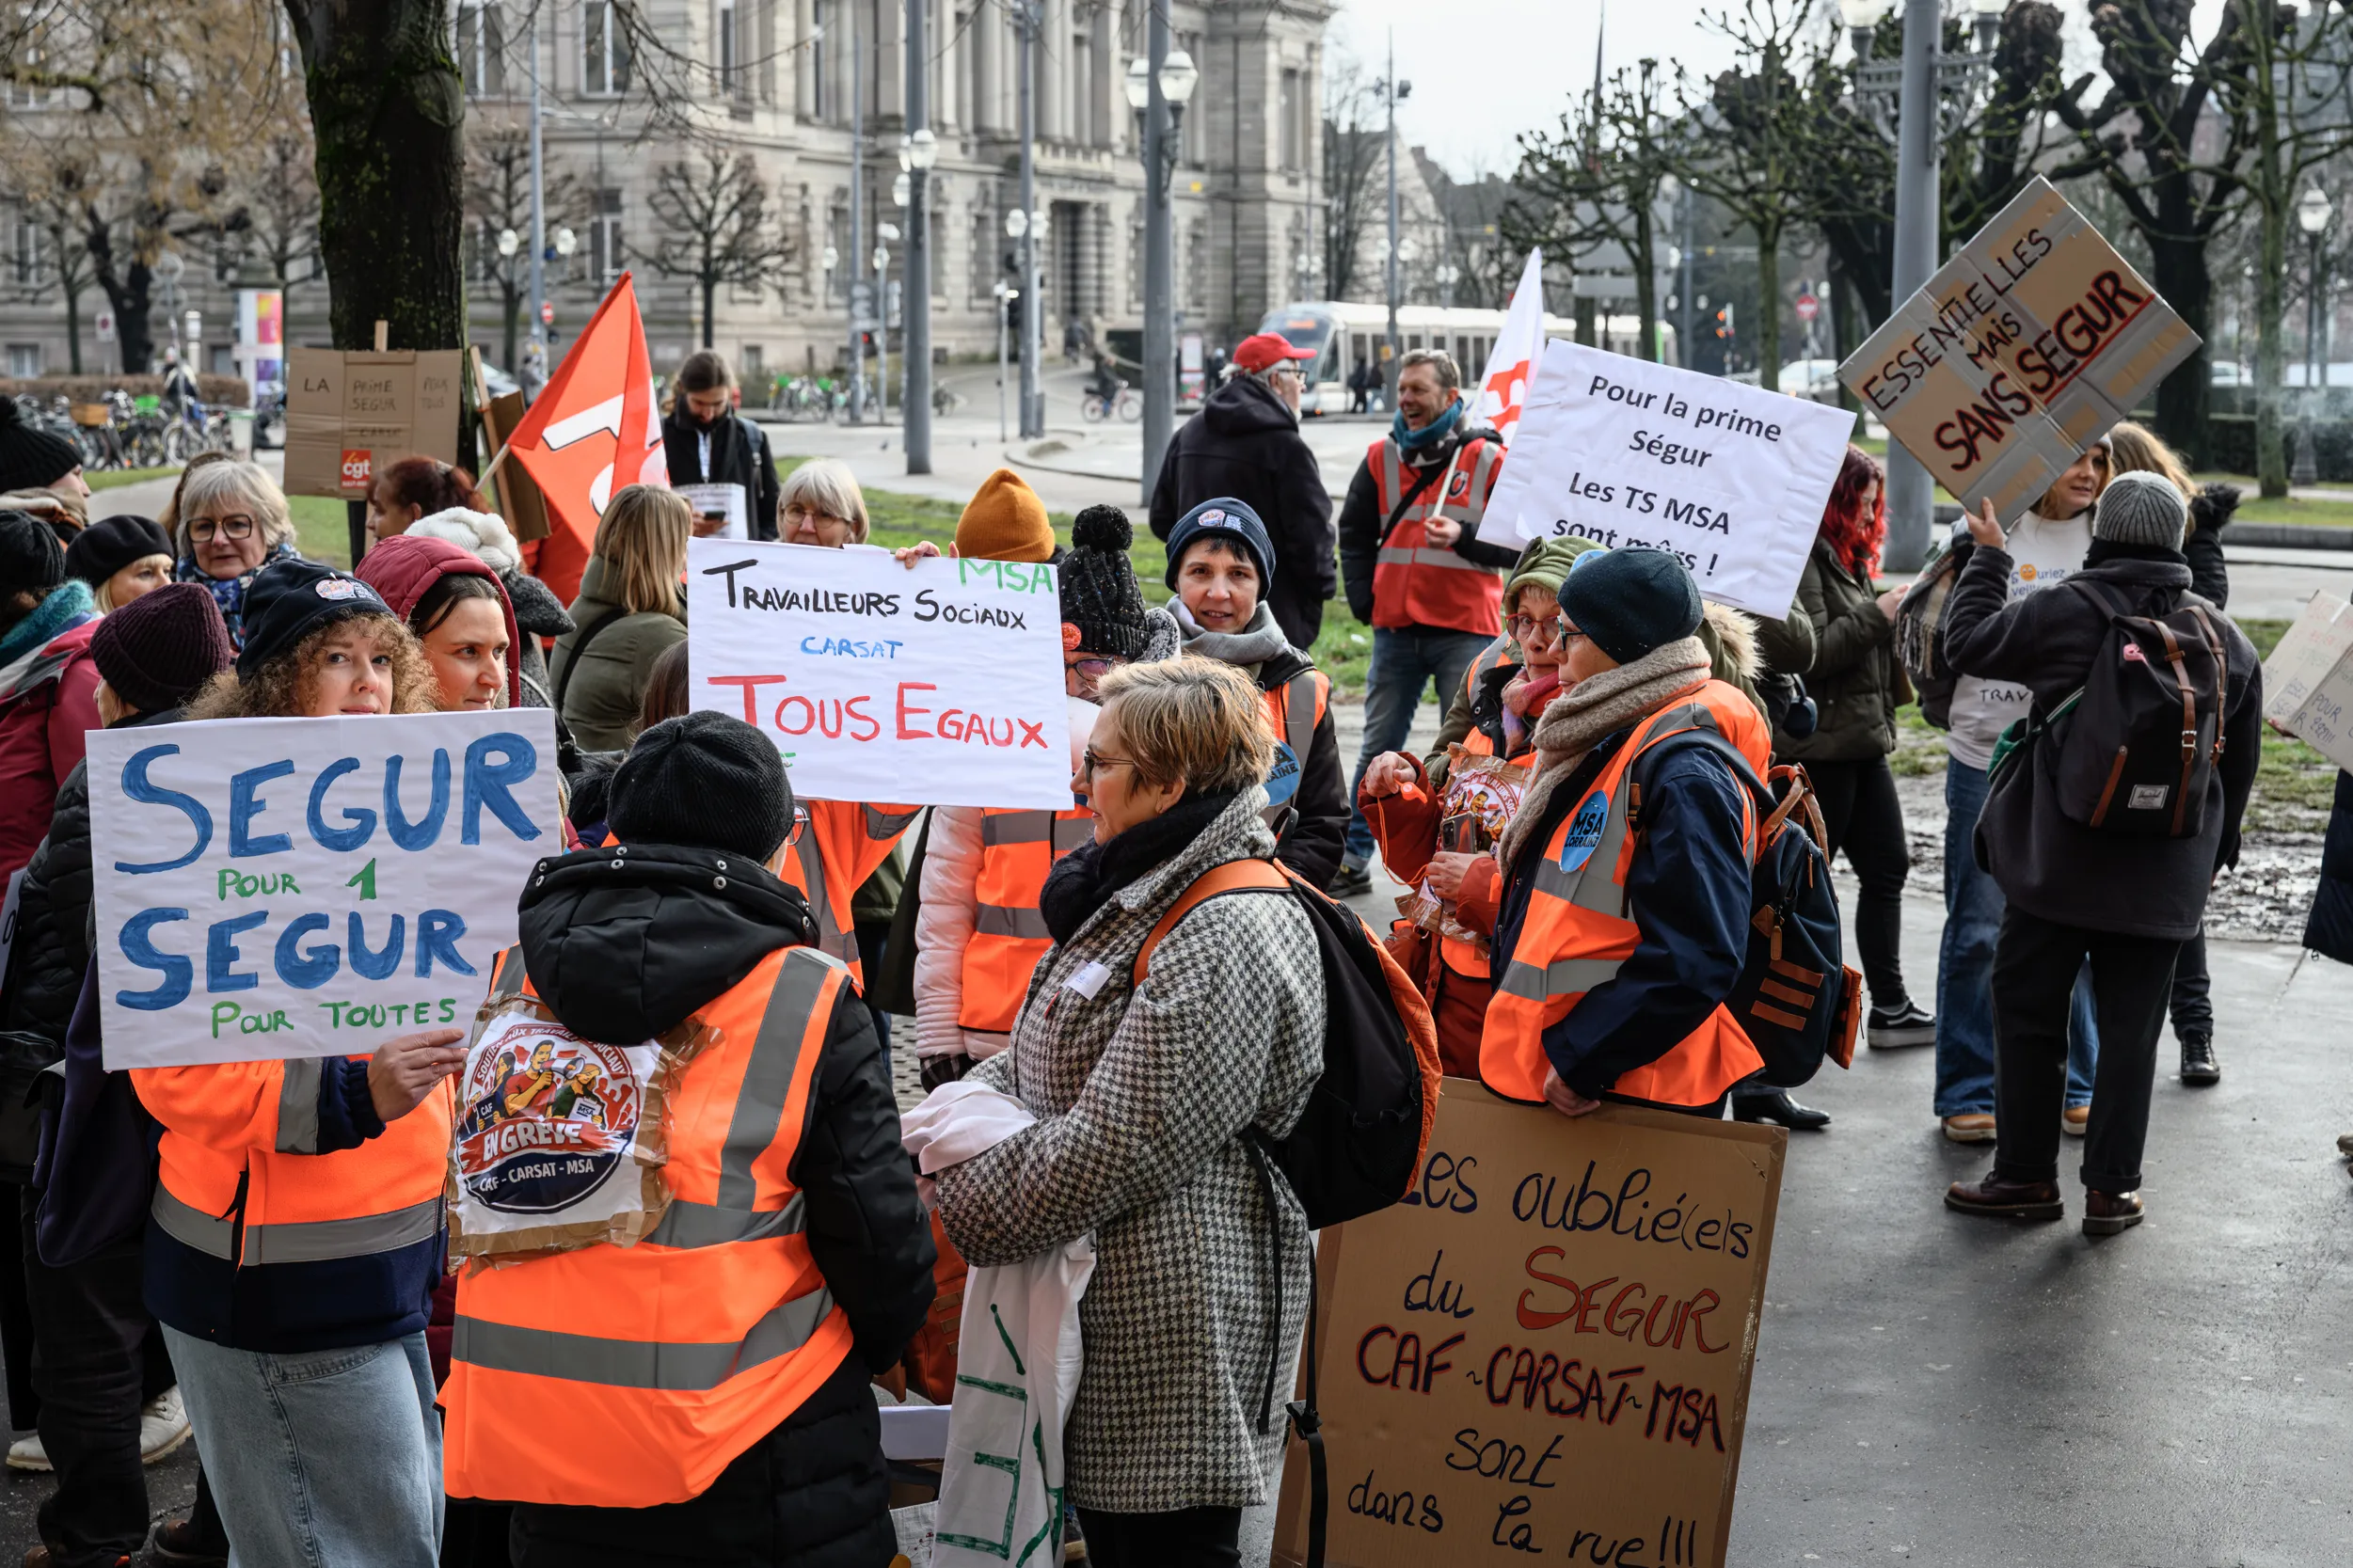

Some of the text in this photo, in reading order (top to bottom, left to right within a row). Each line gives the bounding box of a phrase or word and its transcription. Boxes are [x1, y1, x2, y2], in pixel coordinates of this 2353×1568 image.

[303, 378, 331, 392] LA
[1934, 270, 2145, 471] SANS SEGUR
[1588, 374, 1782, 442] Pour la prime
[1629, 429, 1712, 467] Ségur
[342, 458, 372, 479] cgt
[1568, 471, 1730, 535] Les TS MSA
[1552, 518, 1618, 550] sont
[958, 558, 1055, 594] MSA
[800, 636, 904, 659] CARSAT
[707, 674, 1049, 749] TOUS EGAUX
[2311, 692, 2343, 724] POUR
[114, 731, 544, 875] SEGUR
[1570, 812, 1605, 836] MSA
[217, 858, 377, 901] POUR 1
[115, 906, 478, 1011] SEGUR
[211, 998, 456, 1038] POUR TOUTES
[480, 1101, 493, 1117] CAF
[579, 1105, 595, 1116] MSA
[483, 1130, 501, 1162] EN
[479, 1177, 501, 1193] CAF
[508, 1162, 557, 1183] CARSAT
[566, 1159, 596, 1175] MSA
[1403, 1245, 1730, 1354] du SEGUR
[1356, 1323, 1467, 1395] CAF
[1445, 1427, 1565, 1488] sont
[1347, 1469, 1444, 1534] dans
[1492, 1495, 1544, 1554] la
